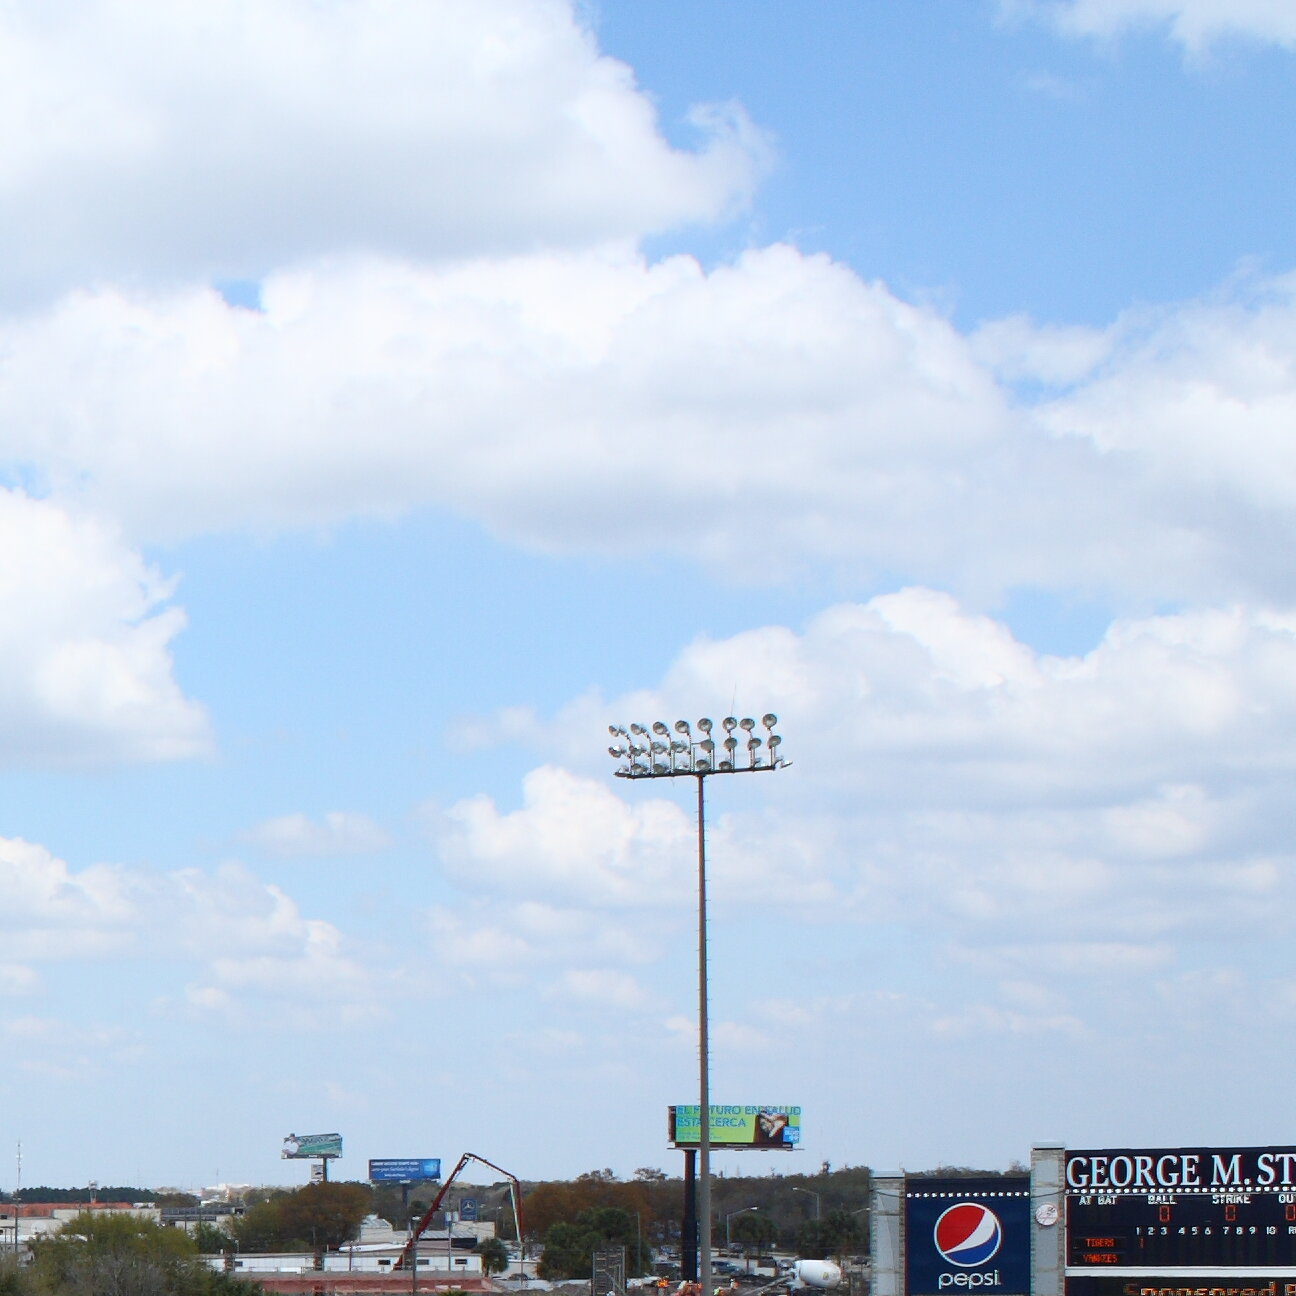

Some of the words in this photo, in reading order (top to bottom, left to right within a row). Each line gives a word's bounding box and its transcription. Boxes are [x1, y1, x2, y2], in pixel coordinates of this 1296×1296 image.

[677, 1106, 689, 1115] EL
[694, 1105, 742, 1115] FTURO
[1066, 1155, 1201, 1188] GEORGE
[1211, 1154, 1251, 1186] M.
[1079, 1196, 1092, 1205] AT
[1097, 1196, 1117, 1205] BAT
[1147, 1195, 1177, 1205] BALL
[1212, 1195, 1251, 1204] STRIKE
[1136, 1226, 1141, 1235] 1
[1148, 1226, 1155, 1235] 2
[1160, 1226, 1168, 1235] 3
[1178, 1226, 1186, 1235] 4
[1191, 1226, 1199, 1235] 5
[1204, 1226, 1212, 1235] 6
[1223, 1226, 1230, 1235] 7
[1236, 1226, 1244, 1235] 8
[1248, 1226, 1257, 1235] 9
[938, 1269, 999, 1290] pepsi
